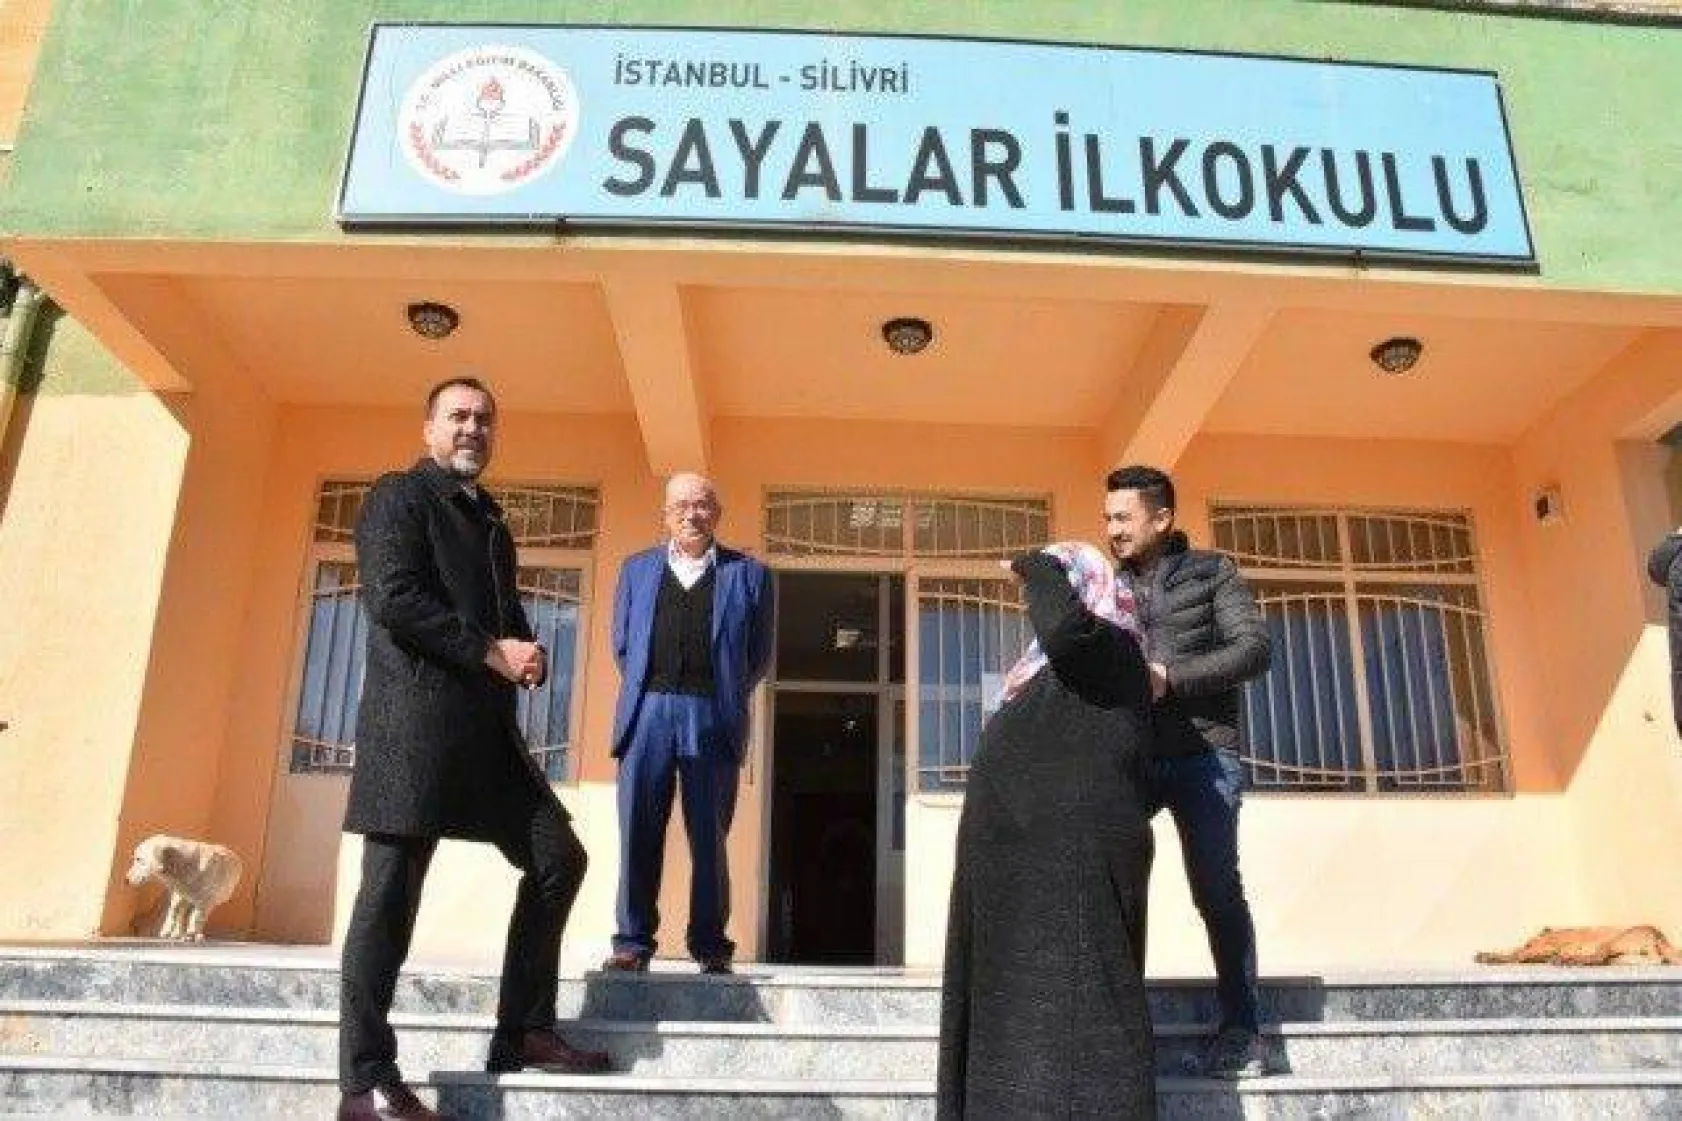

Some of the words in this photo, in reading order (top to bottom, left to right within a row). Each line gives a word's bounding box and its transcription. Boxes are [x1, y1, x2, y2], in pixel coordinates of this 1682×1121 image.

[614, 53, 769, 89] İSTANBUL
[801, 60, 910, 94] SİLİVRİ
[602, 117, 1027, 209] SAYALAR
[1054, 110, 1489, 235] İLKOKULU
